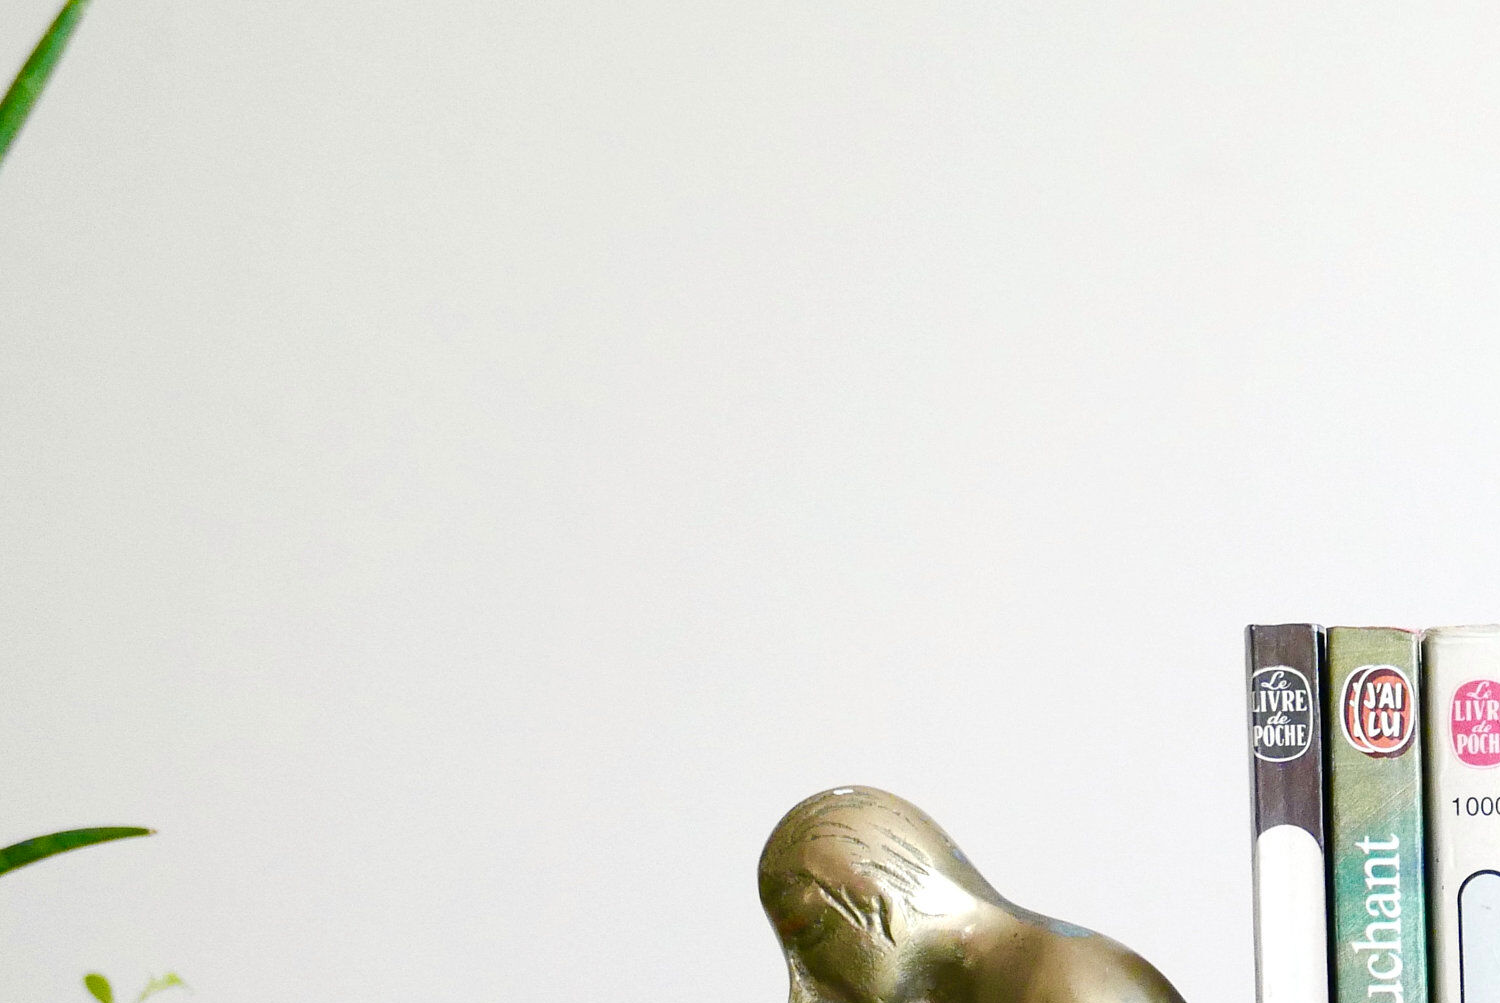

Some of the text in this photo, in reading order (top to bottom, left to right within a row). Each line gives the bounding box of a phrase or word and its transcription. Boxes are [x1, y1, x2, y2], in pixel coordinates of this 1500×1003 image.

[1261, 671, 1291, 690] Le
[1466, 681, 1492, 699] Le
[1364, 682, 1402, 709] J'AI
[1267, 711, 1290, 725] de
[1368, 711, 1401, 737] LU
[1472, 720, 1492, 732] de
[1254, 725, 1306, 747] POCHE
